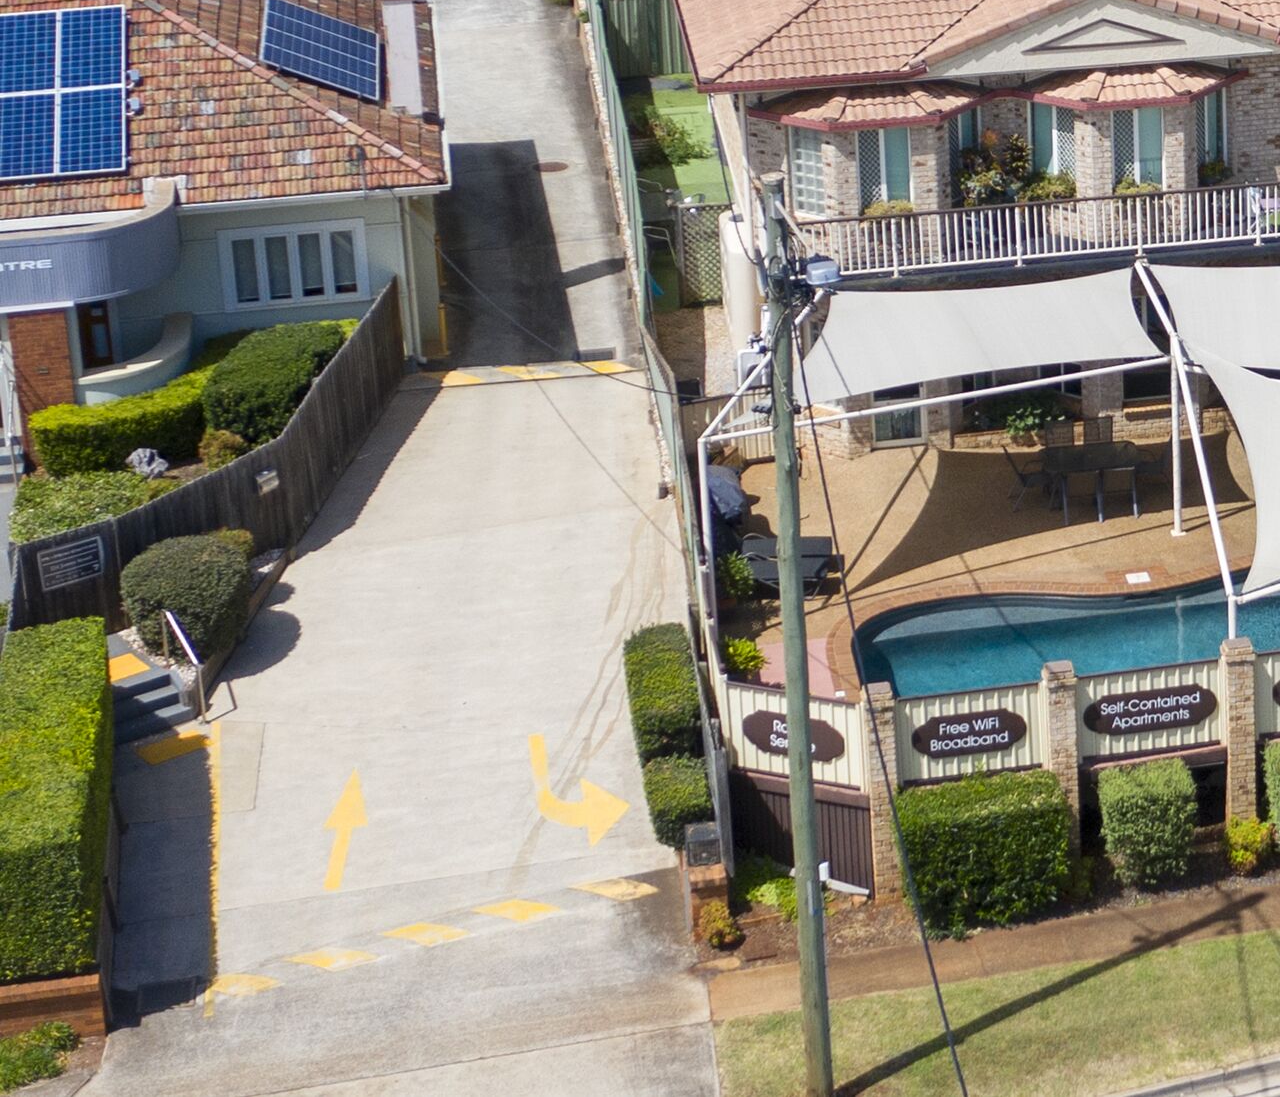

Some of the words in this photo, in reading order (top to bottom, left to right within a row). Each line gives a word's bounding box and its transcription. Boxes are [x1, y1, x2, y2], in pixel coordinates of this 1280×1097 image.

[0, 259, 53, 272] TRE
[1100, 691, 1200, 715] Self-Contained
[939, 723, 970, 736] Free
[972, 716, 1000, 731] WiFi
[1111, 708, 1190, 729] Apartments
[929, 730, 1009, 752] Broadband
